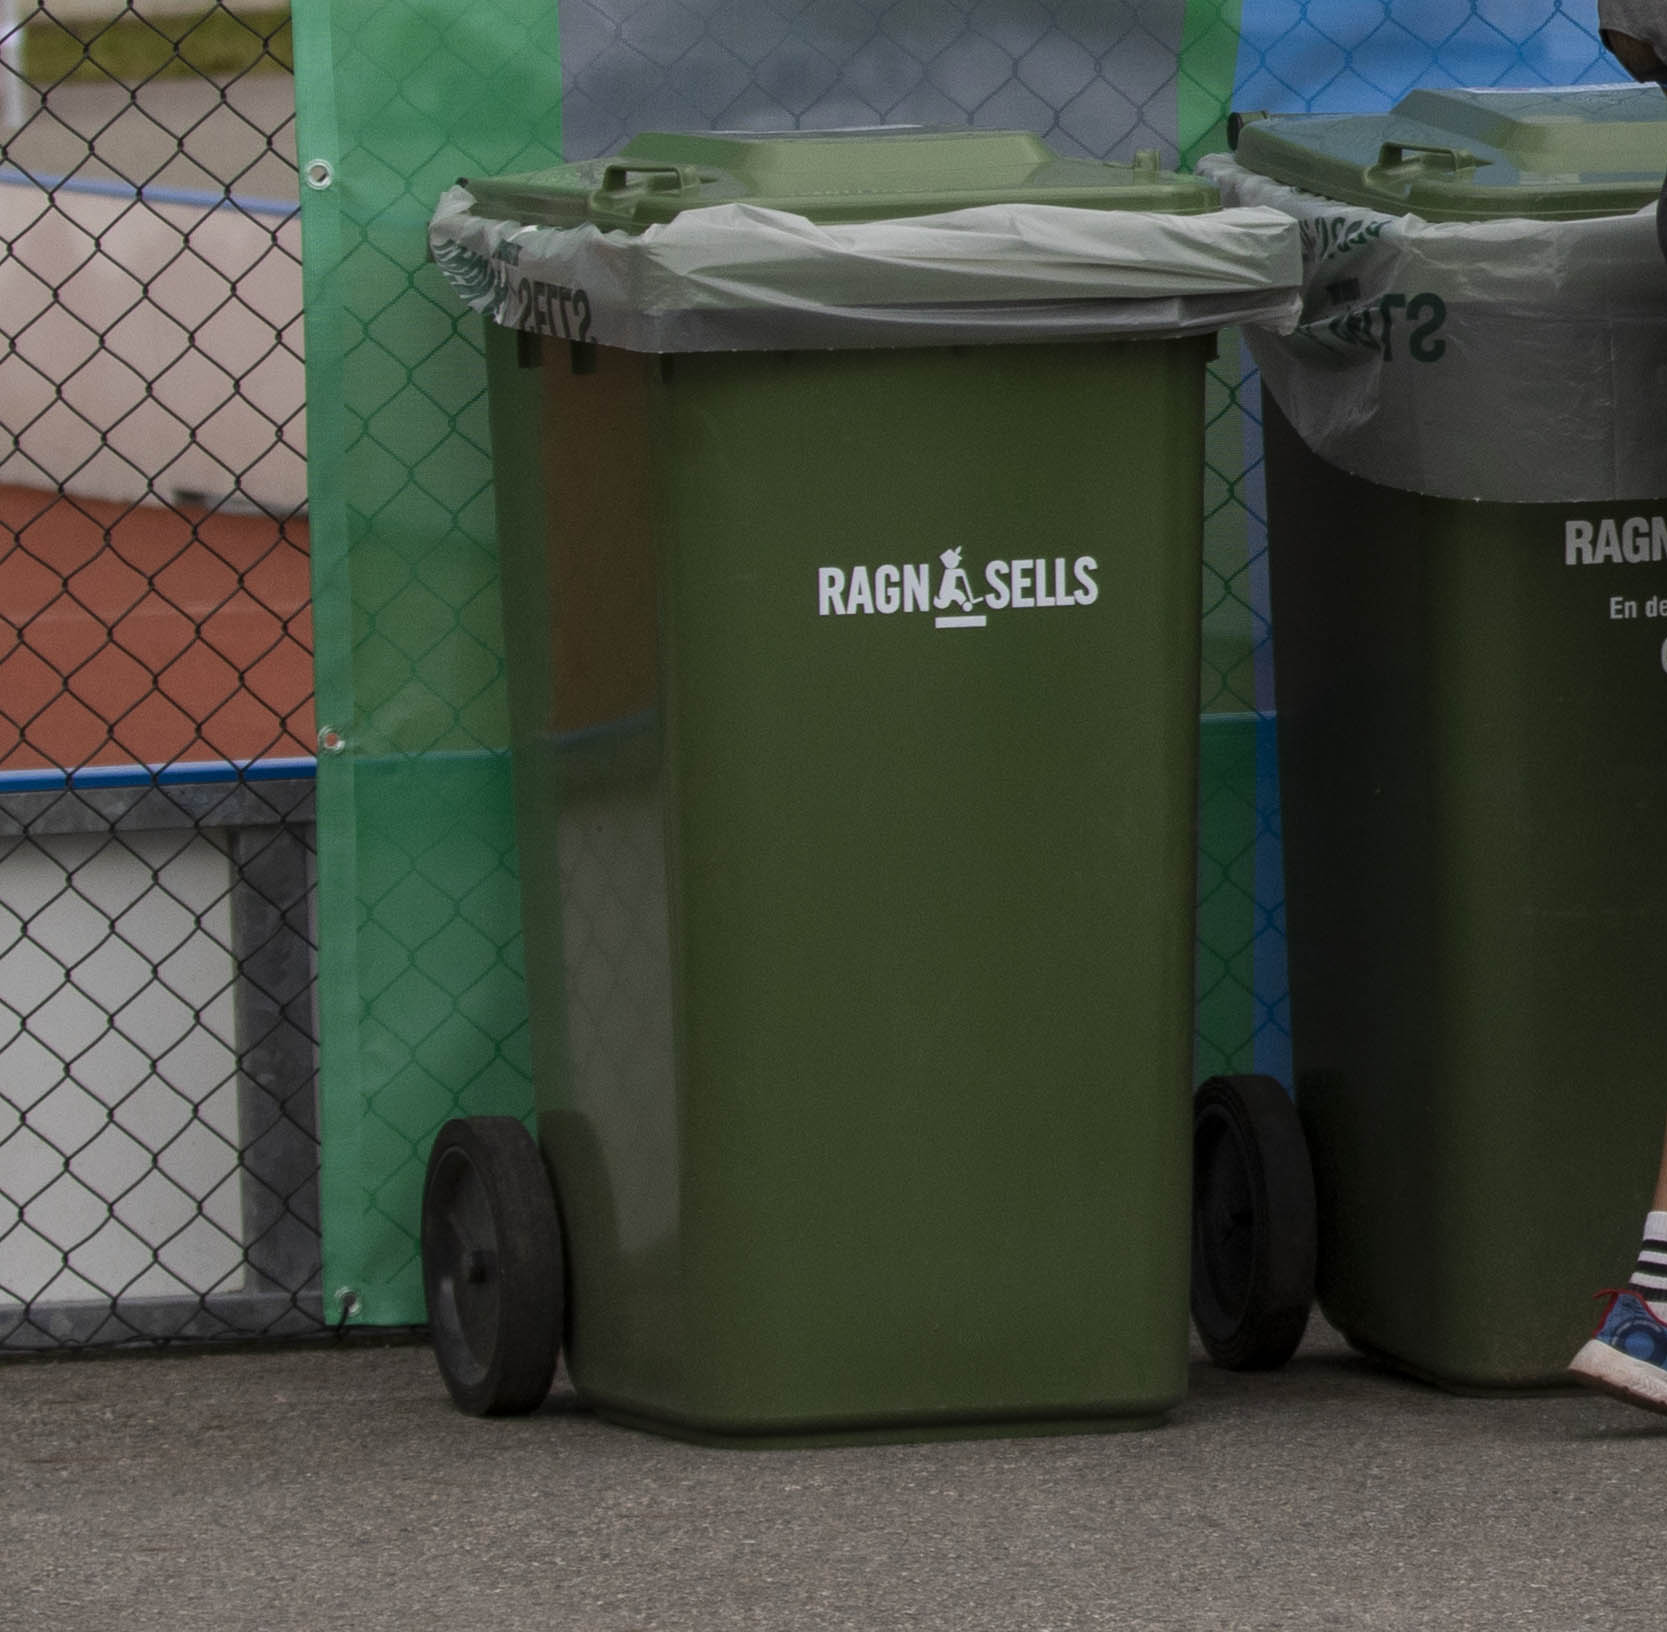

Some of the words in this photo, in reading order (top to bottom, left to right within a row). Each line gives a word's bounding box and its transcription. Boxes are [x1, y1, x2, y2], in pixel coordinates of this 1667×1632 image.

[818, 563, 929, 616] RAGN
[984, 556, 1099, 610] SELLS
[1609, 596, 1637, 619] En
